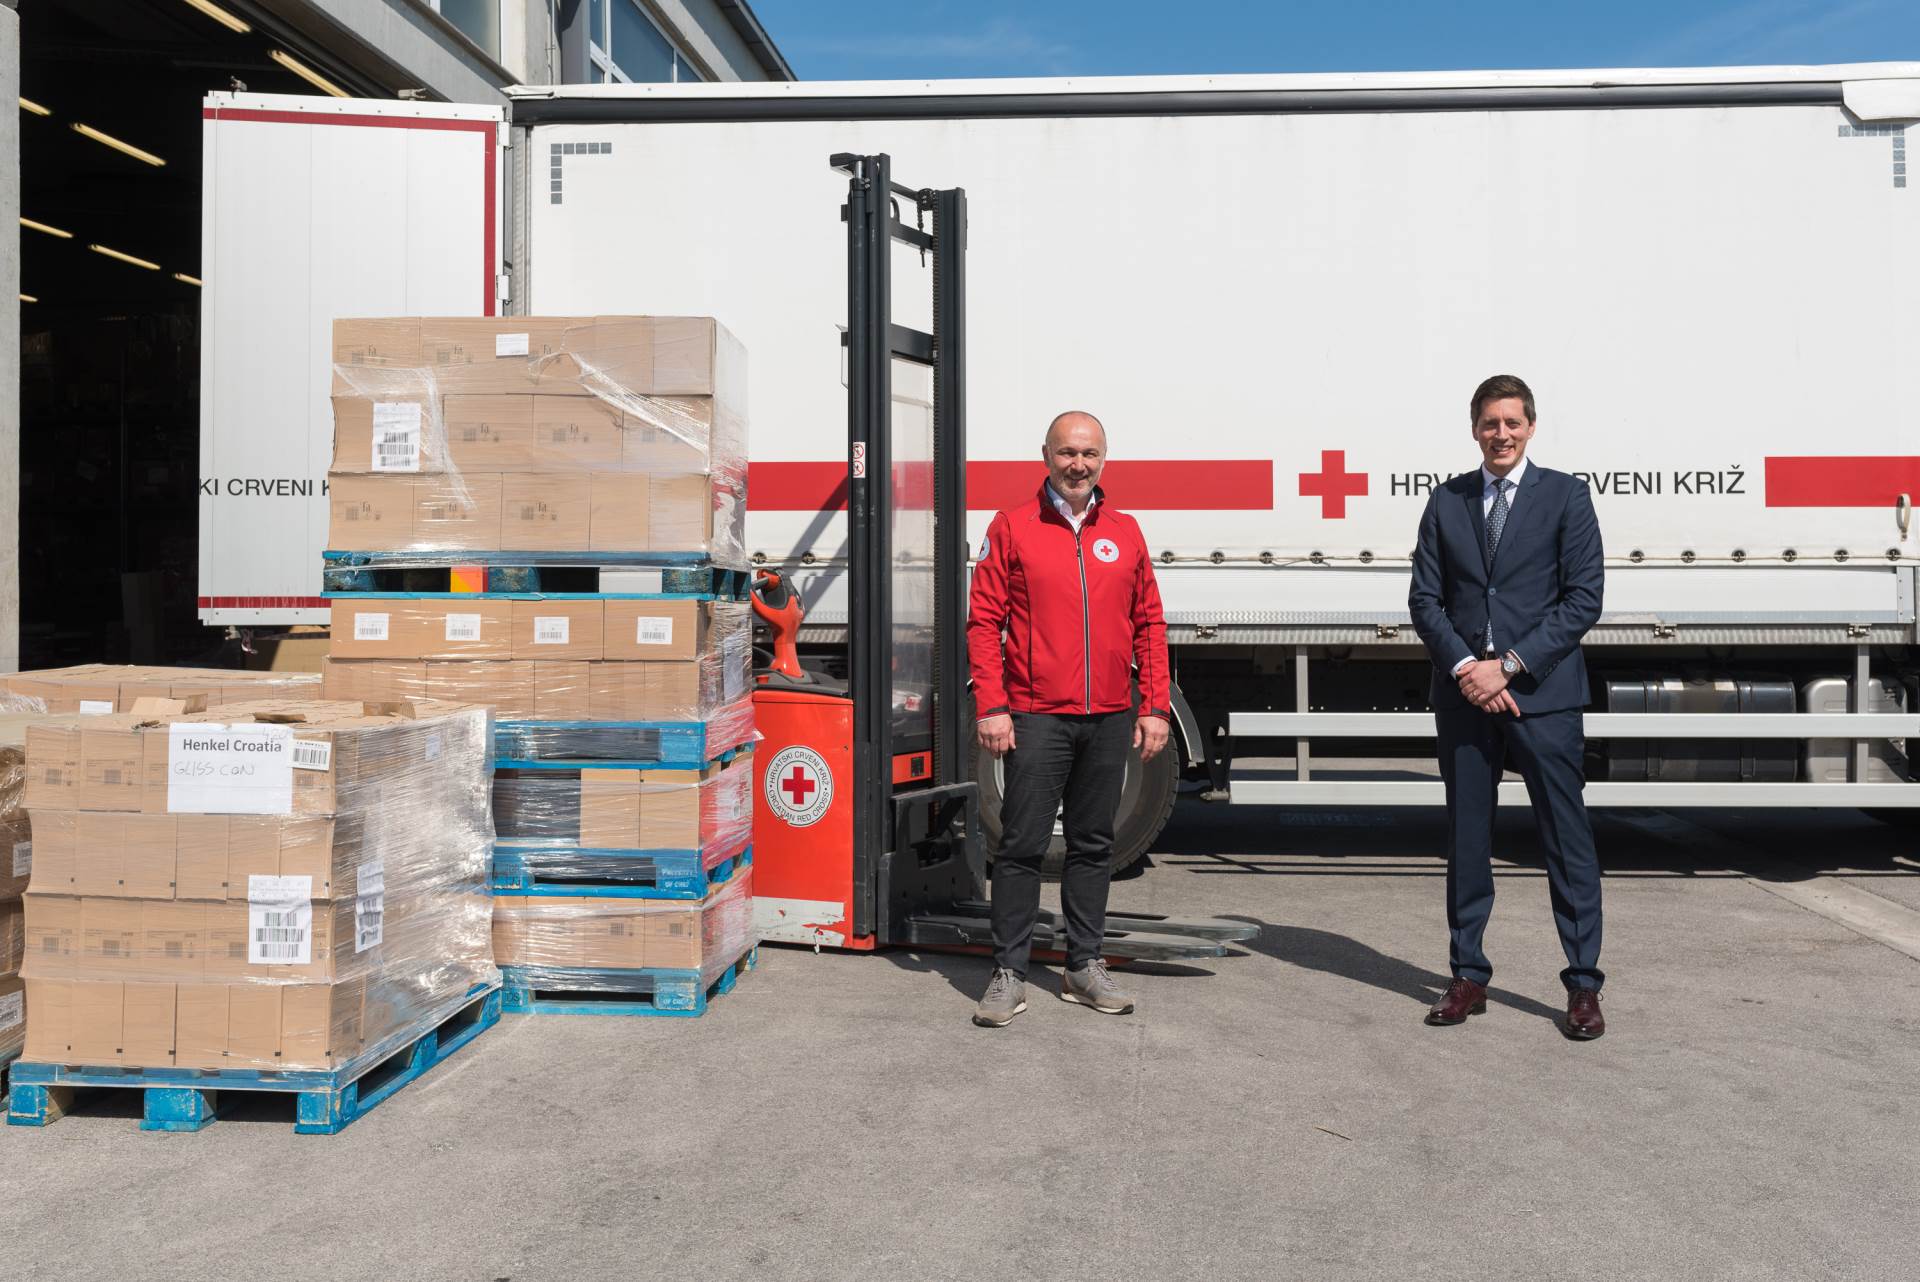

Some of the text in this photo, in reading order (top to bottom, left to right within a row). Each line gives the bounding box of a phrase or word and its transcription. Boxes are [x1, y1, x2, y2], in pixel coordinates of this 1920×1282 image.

[227, 478, 312, 496] CRVENI
[1674, 464, 1745, 494] KRIŽ
[183, 738, 229, 751] Henkel
[233, 739, 282, 752] Croatia
[769, 752, 793, 783] HRVATSKI
[794, 750, 820, 768] CRVENI
[769, 789, 829, 823] CROATIAN RED CROSS
